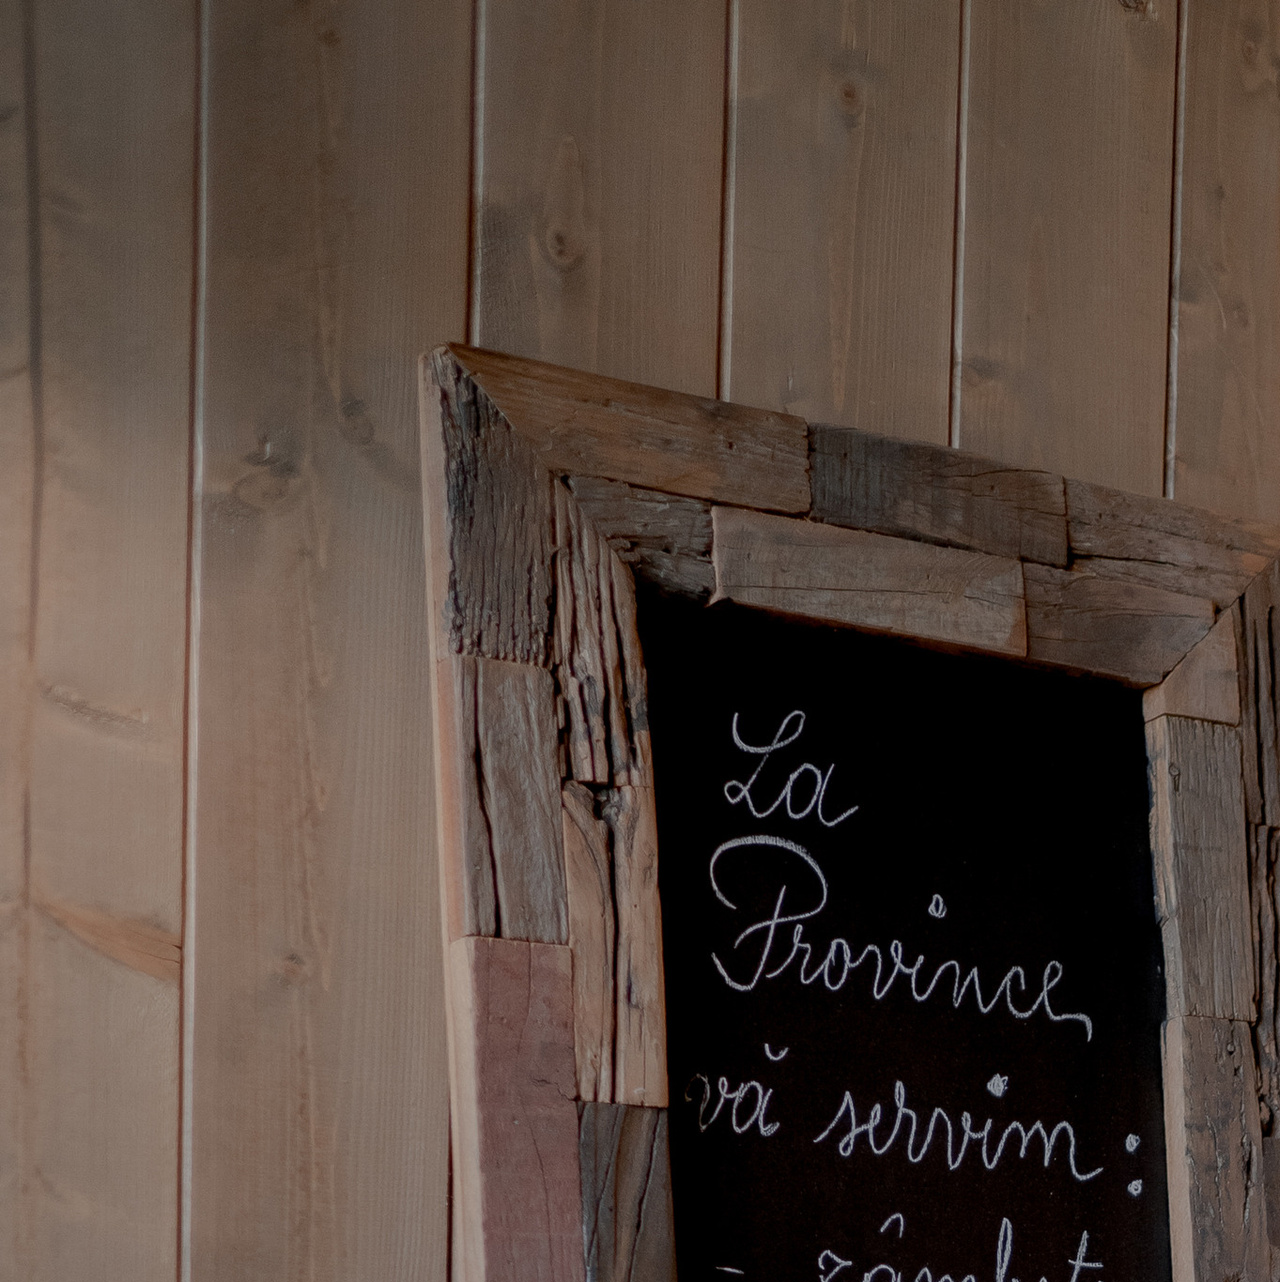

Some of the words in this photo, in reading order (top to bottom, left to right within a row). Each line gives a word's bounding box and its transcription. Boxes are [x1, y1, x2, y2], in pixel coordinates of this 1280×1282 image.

[724, 710, 859, 826] La
[709, 834, 1093, 1043] Province
[685, 1043, 788, 1136] vă
